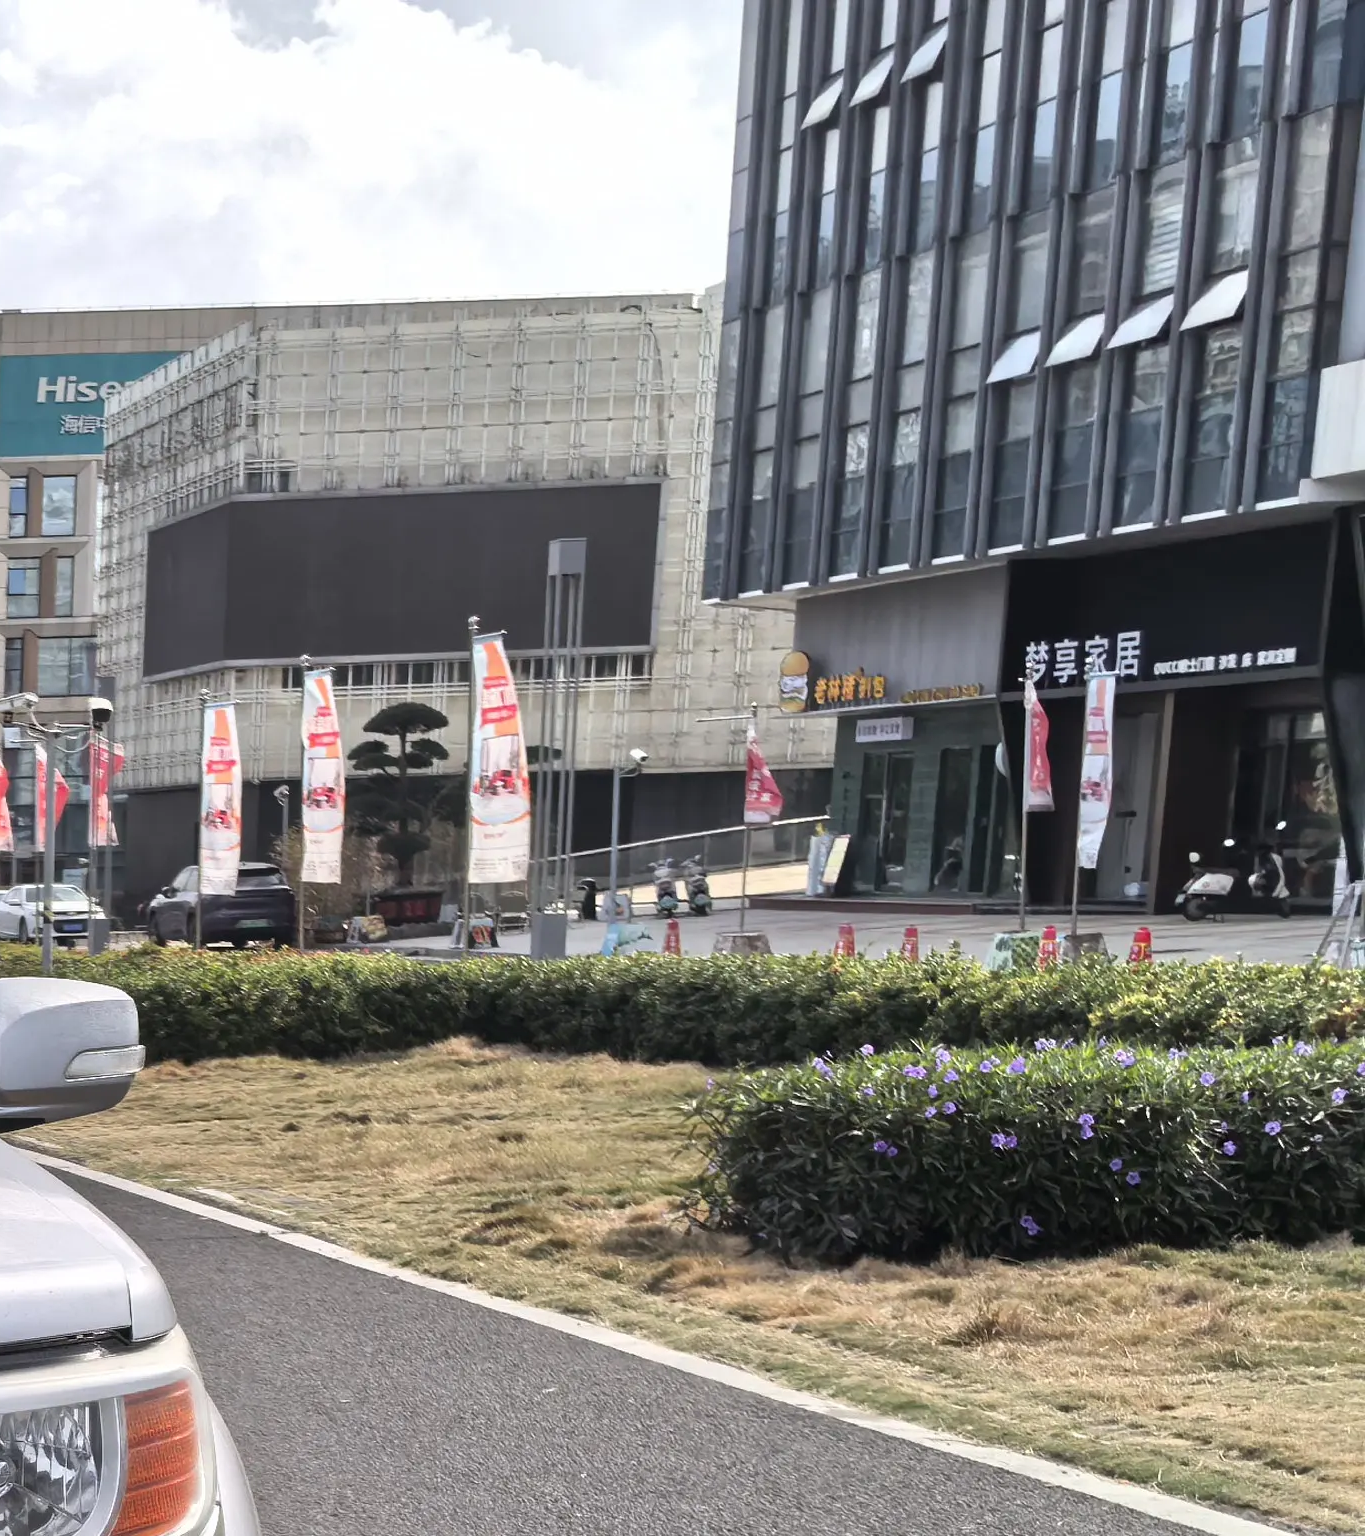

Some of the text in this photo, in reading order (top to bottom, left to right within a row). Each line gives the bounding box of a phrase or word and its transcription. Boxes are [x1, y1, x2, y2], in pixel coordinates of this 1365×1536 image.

[36, 376, 136, 403] Hise
[1025, 630, 1142, 684] 梦享家居
